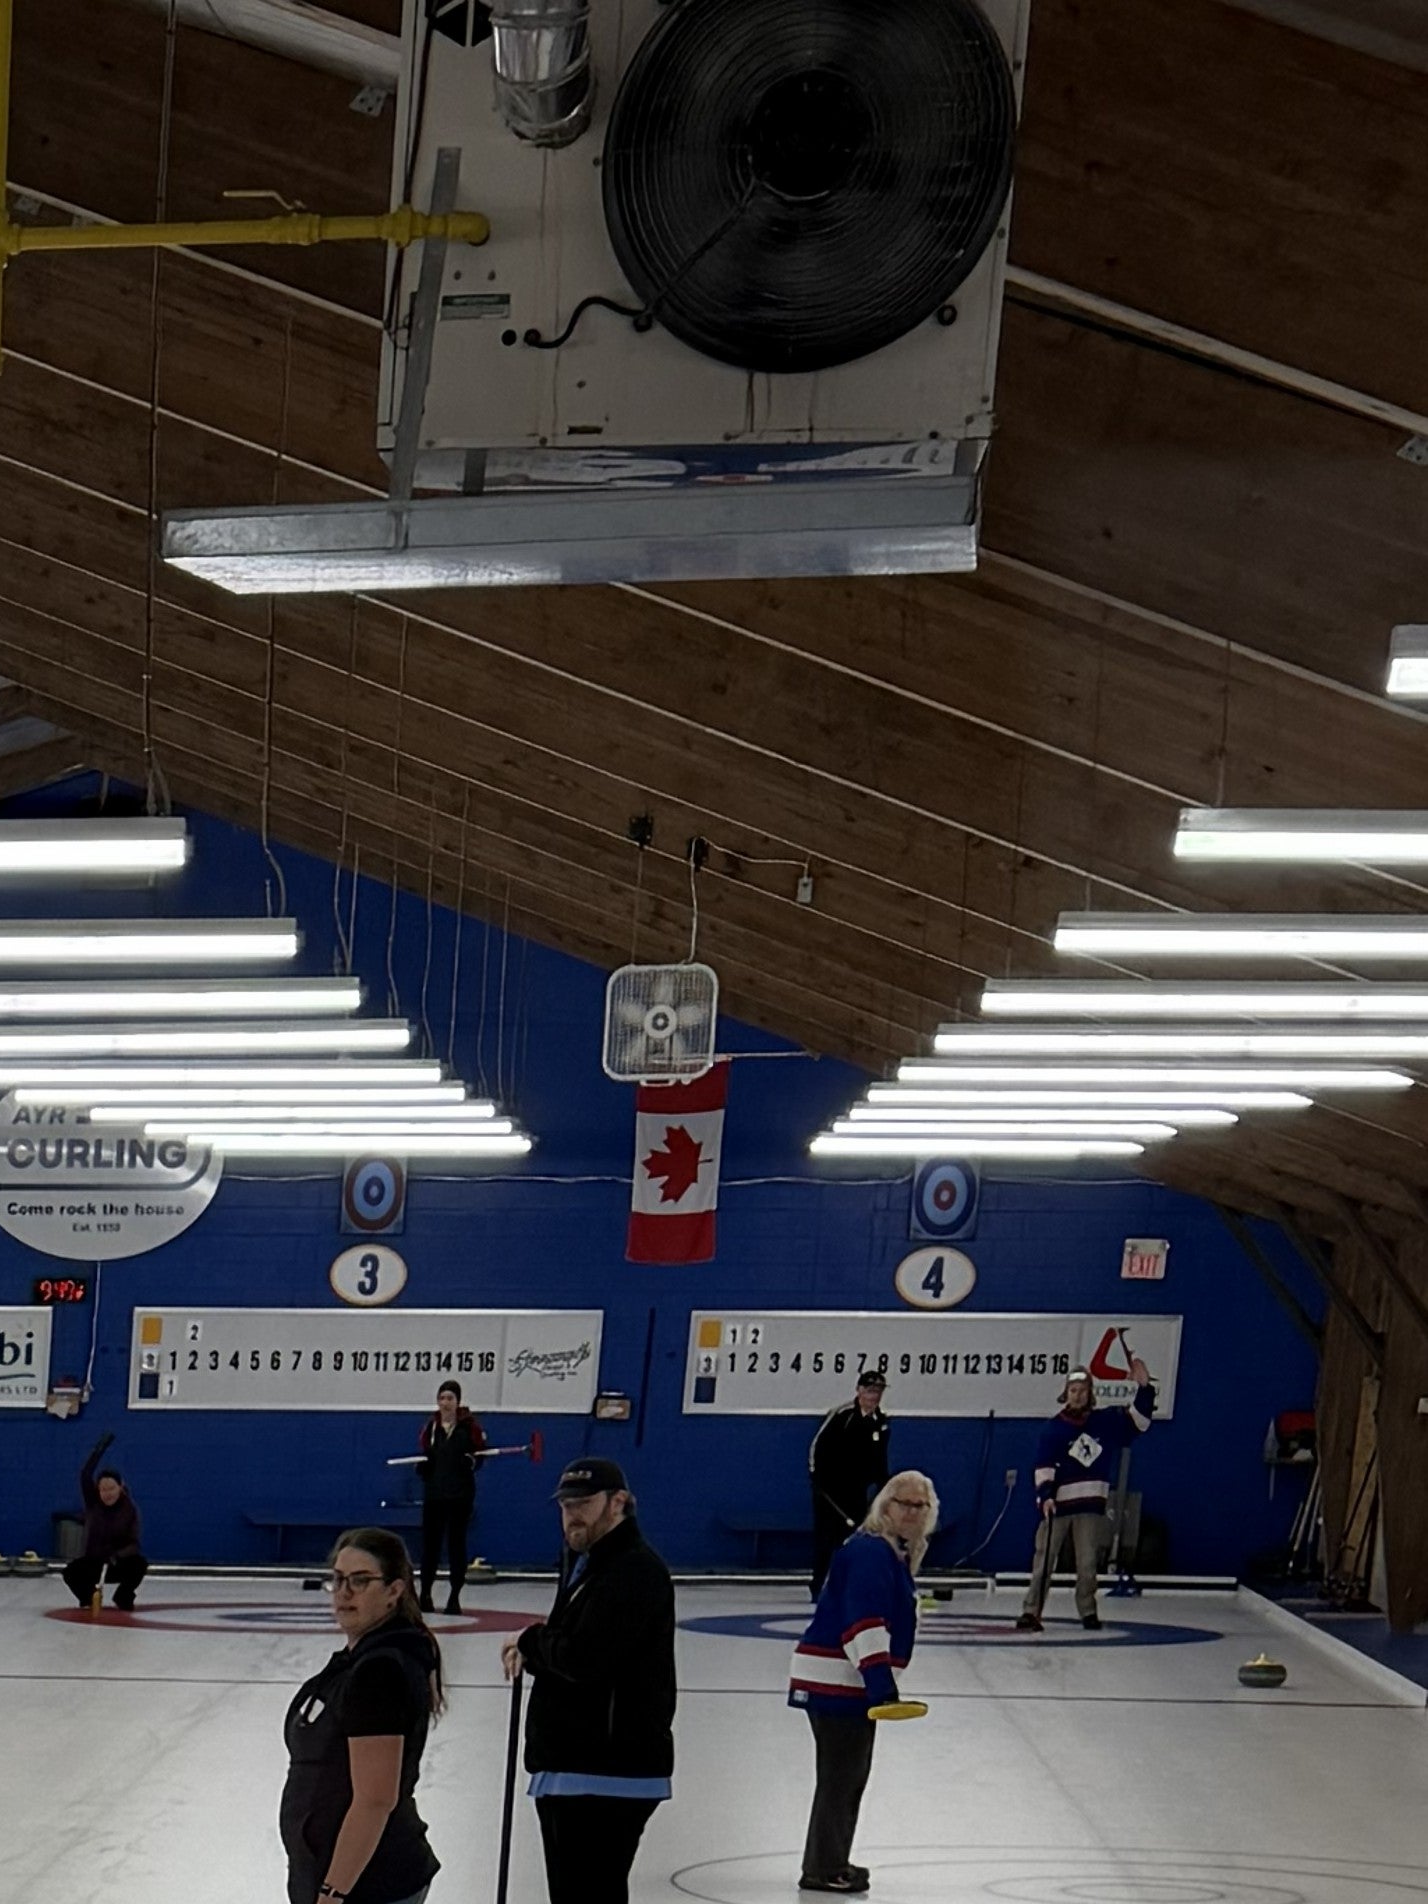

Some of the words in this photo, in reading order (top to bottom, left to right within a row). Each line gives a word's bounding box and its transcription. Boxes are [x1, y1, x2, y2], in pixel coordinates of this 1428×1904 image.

[11, 1105, 66, 1125] AYR
[5, 1138, 188, 1169] CURLING
[6, 1202, 54, 1216] Come
[59, 1202, 96, 1216] rock
[102, 1202, 129, 1216] the
[134, 1203, 185, 1216] house
[357, 1253, 381, 1296] 3
[921, 1255, 945, 1299] 4
[189, 1324, 200, 1341] 2
[730, 1328, 738, 1345] 1
[750, 1328, 761, 1345] 2
[187, 1349, 199, 1371] 2
[209, 1349, 220, 1371] 3
[228, 1350, 240, 1371] 4
[249, 1350, 260, 1371] 5
[270, 1350, 281, 1371] 6
[291, 1350, 303, 1371] 7
[311, 1350, 323, 1372] 8
[333, 1350, 344, 1372] 9
[351, 1350, 369, 1372] 10
[373, 1351, 389, 1372] 11
[393, 1350, 411, 1372] 12
[414, 1351, 432, 1372] 13
[435, 1351, 453, 1372] 14
[456, 1351, 474, 1372] 15
[478, 1351, 495, 1373] 16
[747, 1351, 759, 1373] 2
[768, 1352, 781, 1374] 3
[790, 1352, 802, 1373] 4
[812, 1351, 824, 1374] 5
[833, 1352, 846, 1374] 6
[856, 1352, 868, 1374] 7
[876, 1353, 890, 1375] 8
[899, 1353, 911, 1375] 9
[918, 1353, 937, 1375] 10
[942, 1353, 958, 1375] 11
[963, 1353, 981, 1375] 12
[985, 1353, 1004, 1375] 13
[1007, 1353, 1025, 1375] 14
[1028, 1353, 1047, 1375] 15
[1051, 1353, 1070, 1375] 16
